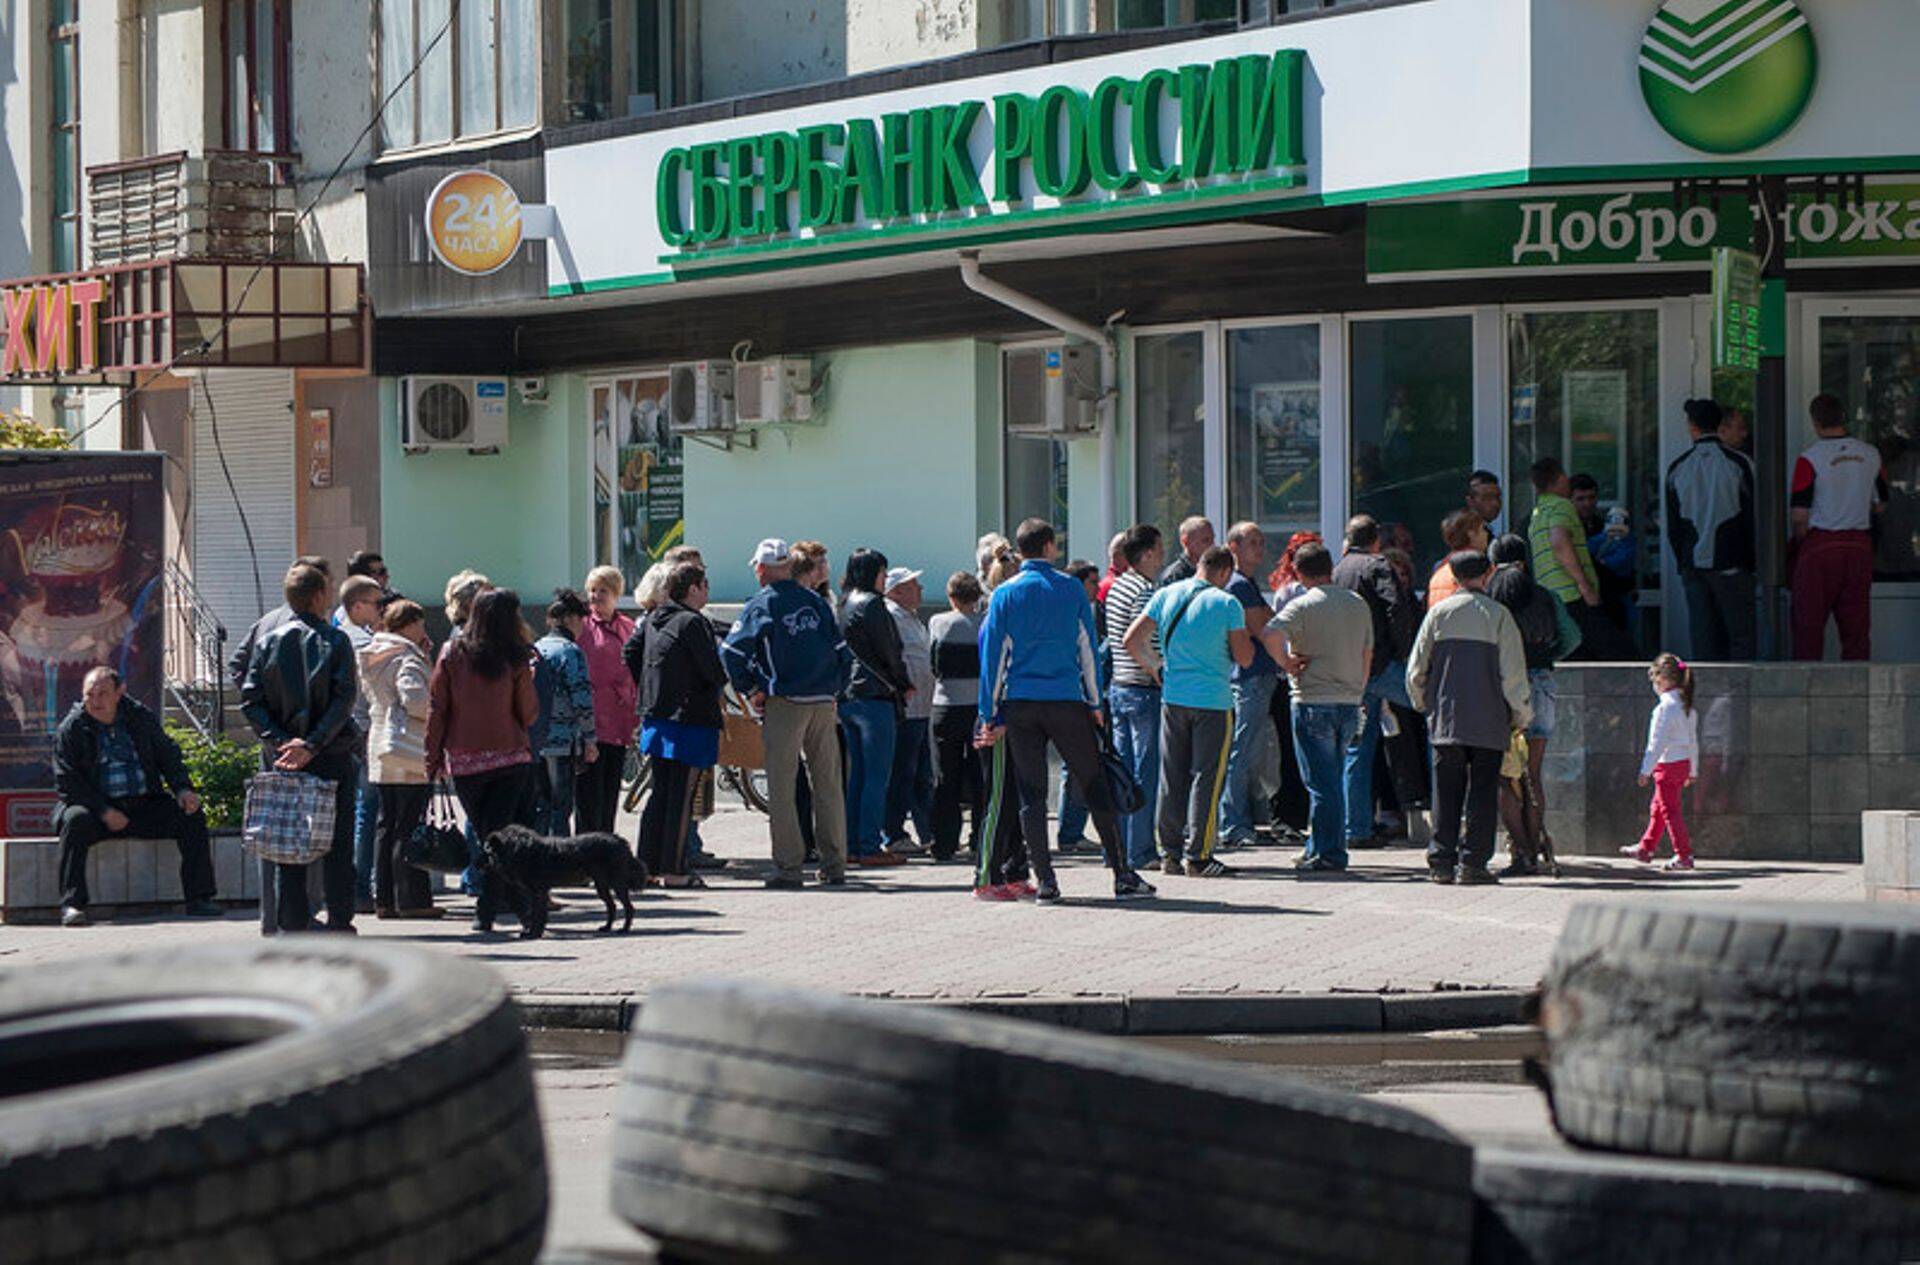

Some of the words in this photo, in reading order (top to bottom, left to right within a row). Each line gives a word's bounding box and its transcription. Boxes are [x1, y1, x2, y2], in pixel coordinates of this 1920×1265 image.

[656, 101, 986, 248] СБЕРБАНК
[992, 48, 1307, 203] РОССИИ
[443, 191, 499, 232] 24
[443, 234, 500, 253] ЧАСА
[1513, 192, 1717, 264] Добро
[2, 280, 106, 374] ХИТ
